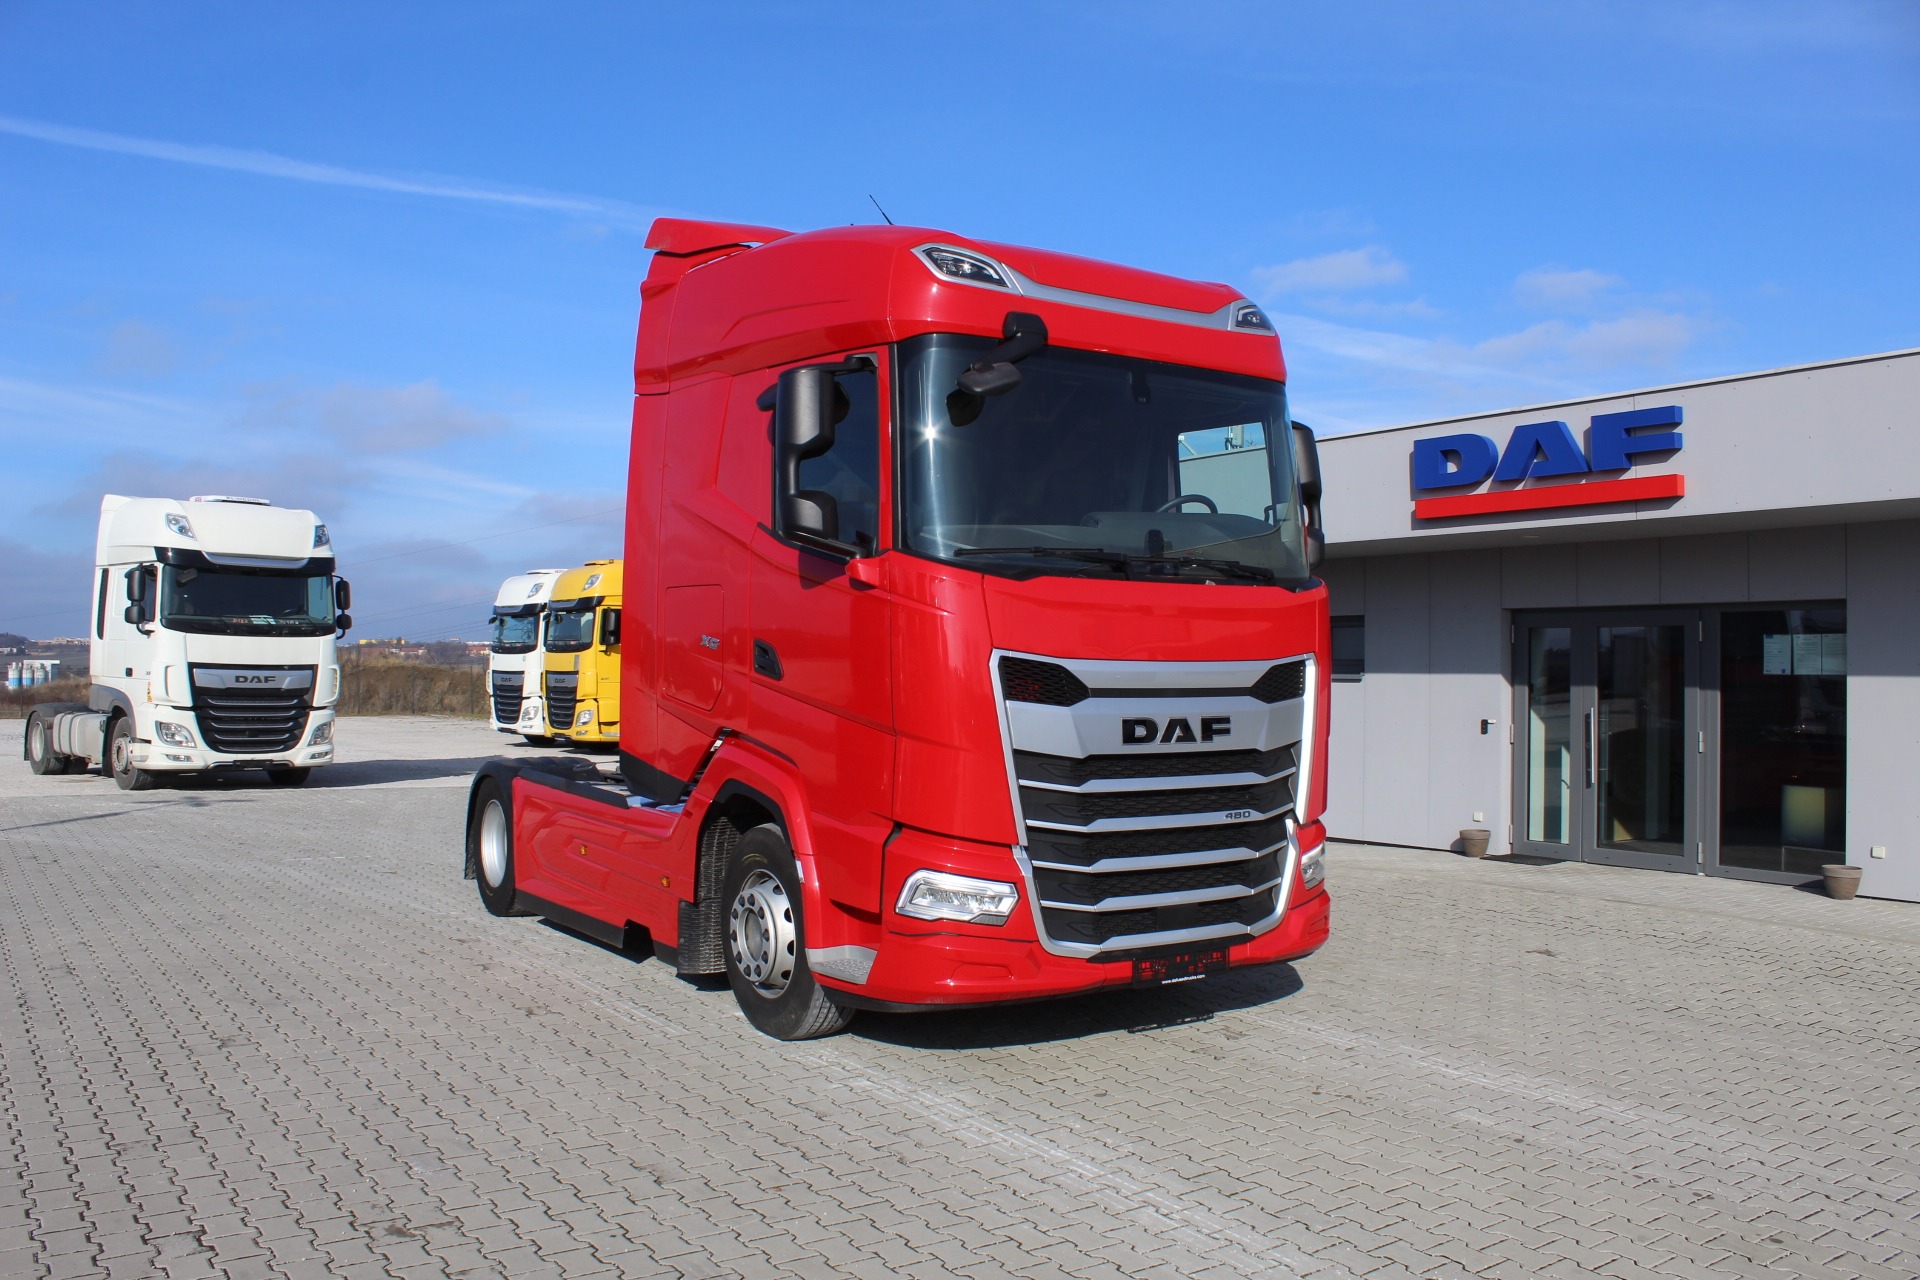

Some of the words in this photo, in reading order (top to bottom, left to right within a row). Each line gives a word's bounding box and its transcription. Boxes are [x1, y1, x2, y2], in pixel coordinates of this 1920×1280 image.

[1414, 405, 1683, 490] DAF
[235, 675, 276, 683] DAF
[1121, 716, 1231, 745] DAF
[1224, 811, 1251, 820] 480
